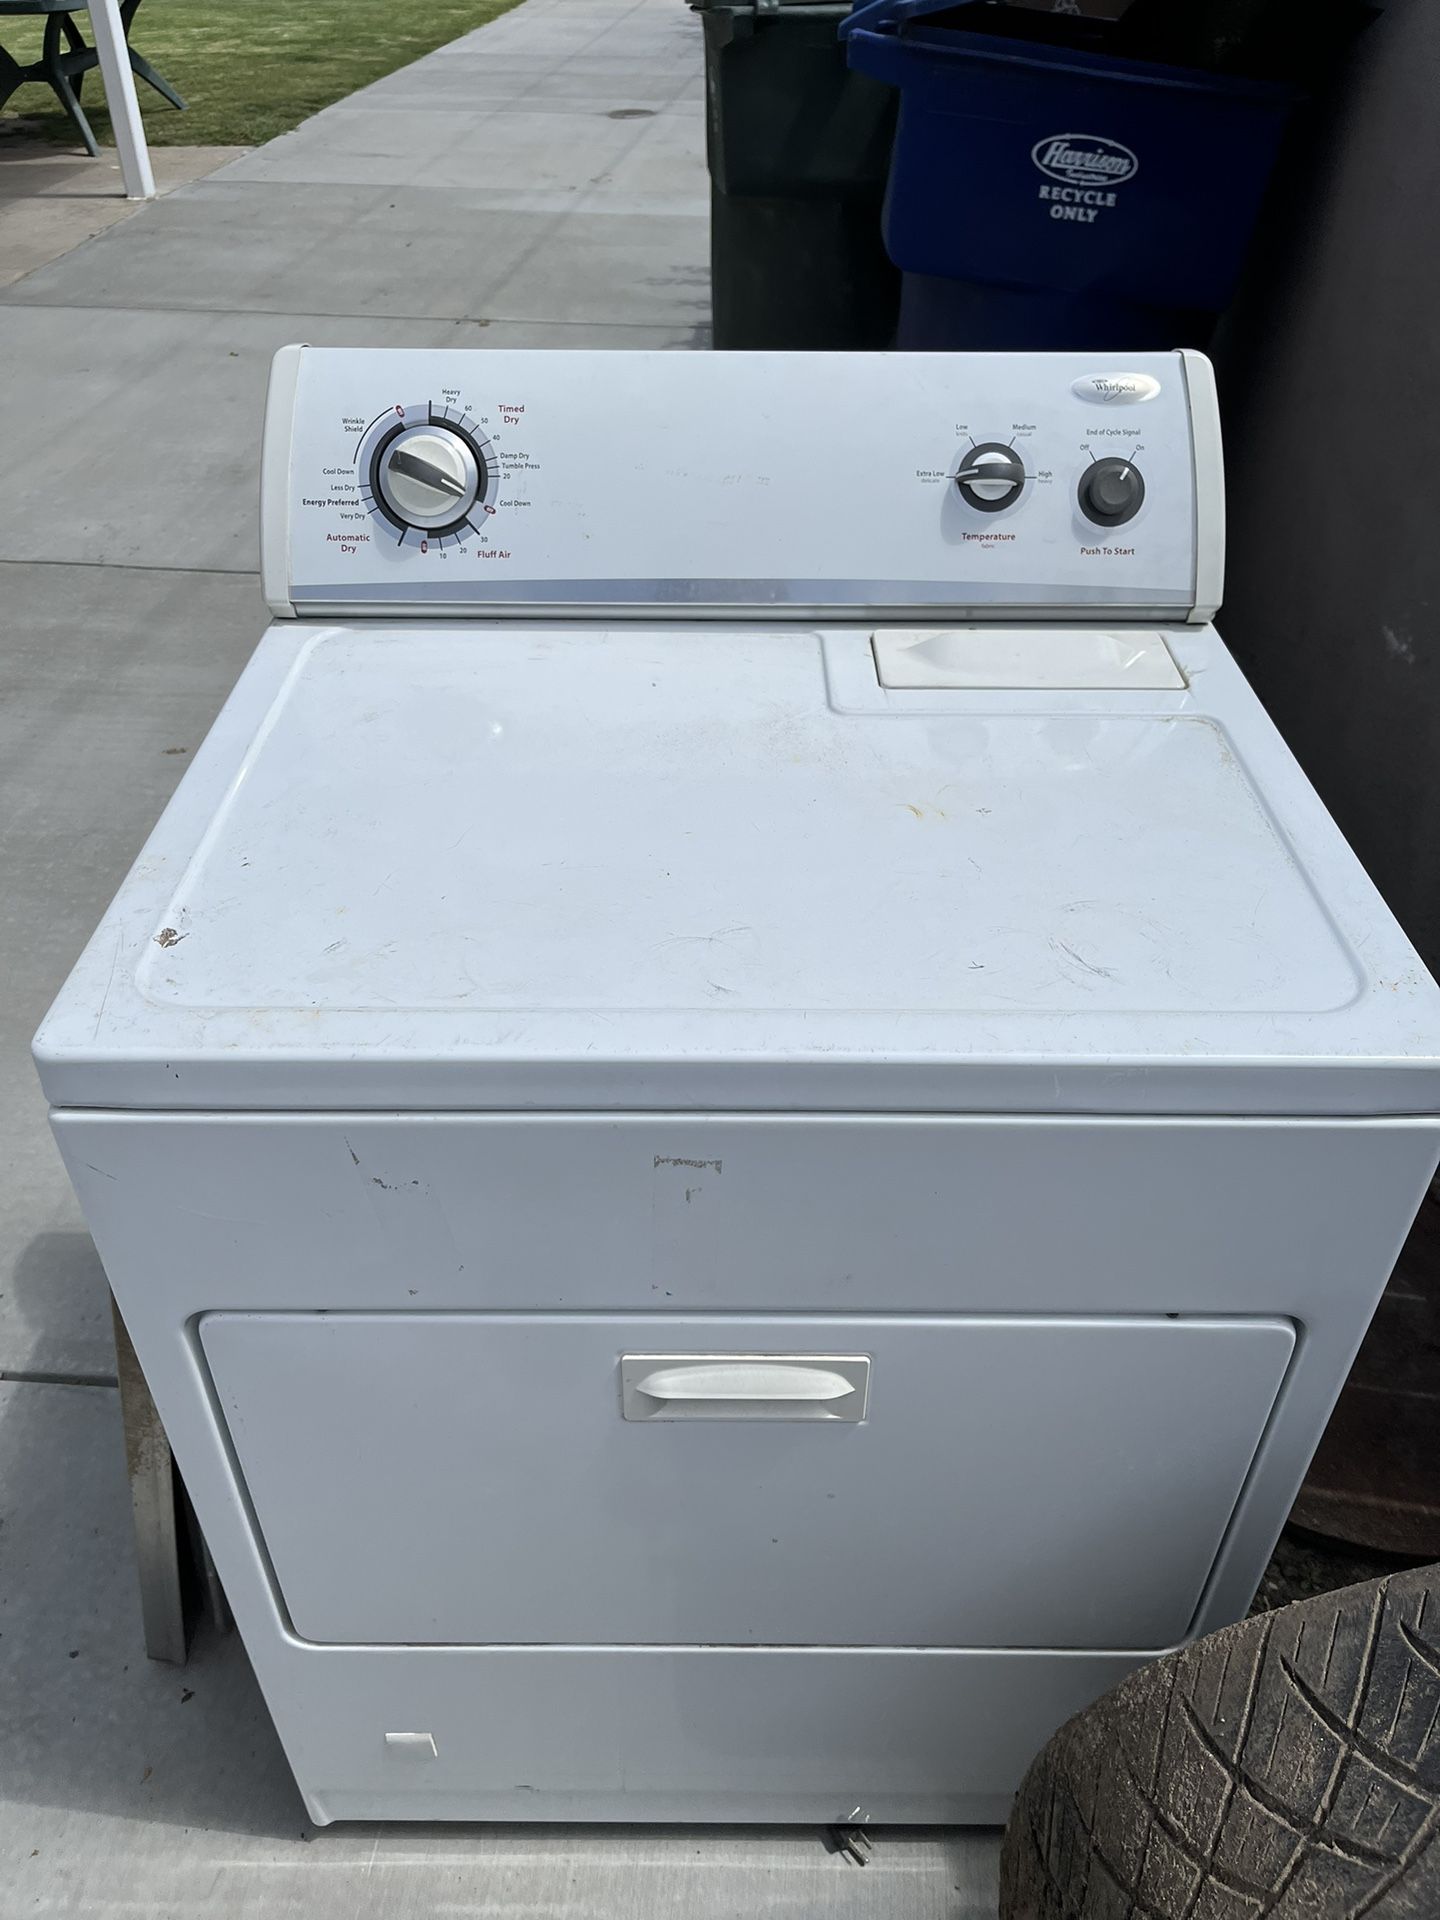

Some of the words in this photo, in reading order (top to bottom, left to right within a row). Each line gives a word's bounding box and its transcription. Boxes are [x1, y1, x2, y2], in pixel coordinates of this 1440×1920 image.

[1041, 141, 1132, 175] Harrison
[1038, 185, 1117, 207] RECYCLE
[1050, 204, 1099, 223] ONLY
[1095, 383, 1136, 392] Whirlpool
[446, 396, 457, 404] Dry
[498, 404, 525, 413] Timed
[504, 415, 519, 425] Dry
[1086, 428, 1098, 436] End
[1106, 428, 1121, 437] Cycle
[1122, 428, 1141, 437] Signal
[500, 452, 517, 460] Damp
[519, 452, 530, 460] Dry
[502, 462, 524, 470] Tumble
[525, 462, 541, 470] Press
[322, 467, 337, 475] Cool
[337, 467, 354, 475] Down
[916, 470, 931, 478] Extra
[932, 470, 945, 478] Low
[1038, 470, 1053, 479] High
[503, 472, 511, 480] 20
[330, 484, 344, 492] Less
[344, 484, 356, 493] Dry
[302, 498, 327, 508] Energy
[327, 498, 360, 507] Preferred
[340, 512, 353, 520] Very
[354, 512, 366, 520] Dry
[326, 533, 371, 542] Automatic
[961, 532, 1016, 542] Temperature
[341, 544, 357, 554] Dry
[1080, 547, 1101, 555] Push
[1102, 547, 1113, 555] To
[1114, 547, 1135, 555] Start
[439, 552, 448, 560] 10
[477, 550, 498, 559] Fluff
[498, 550, 511, 559] Air
